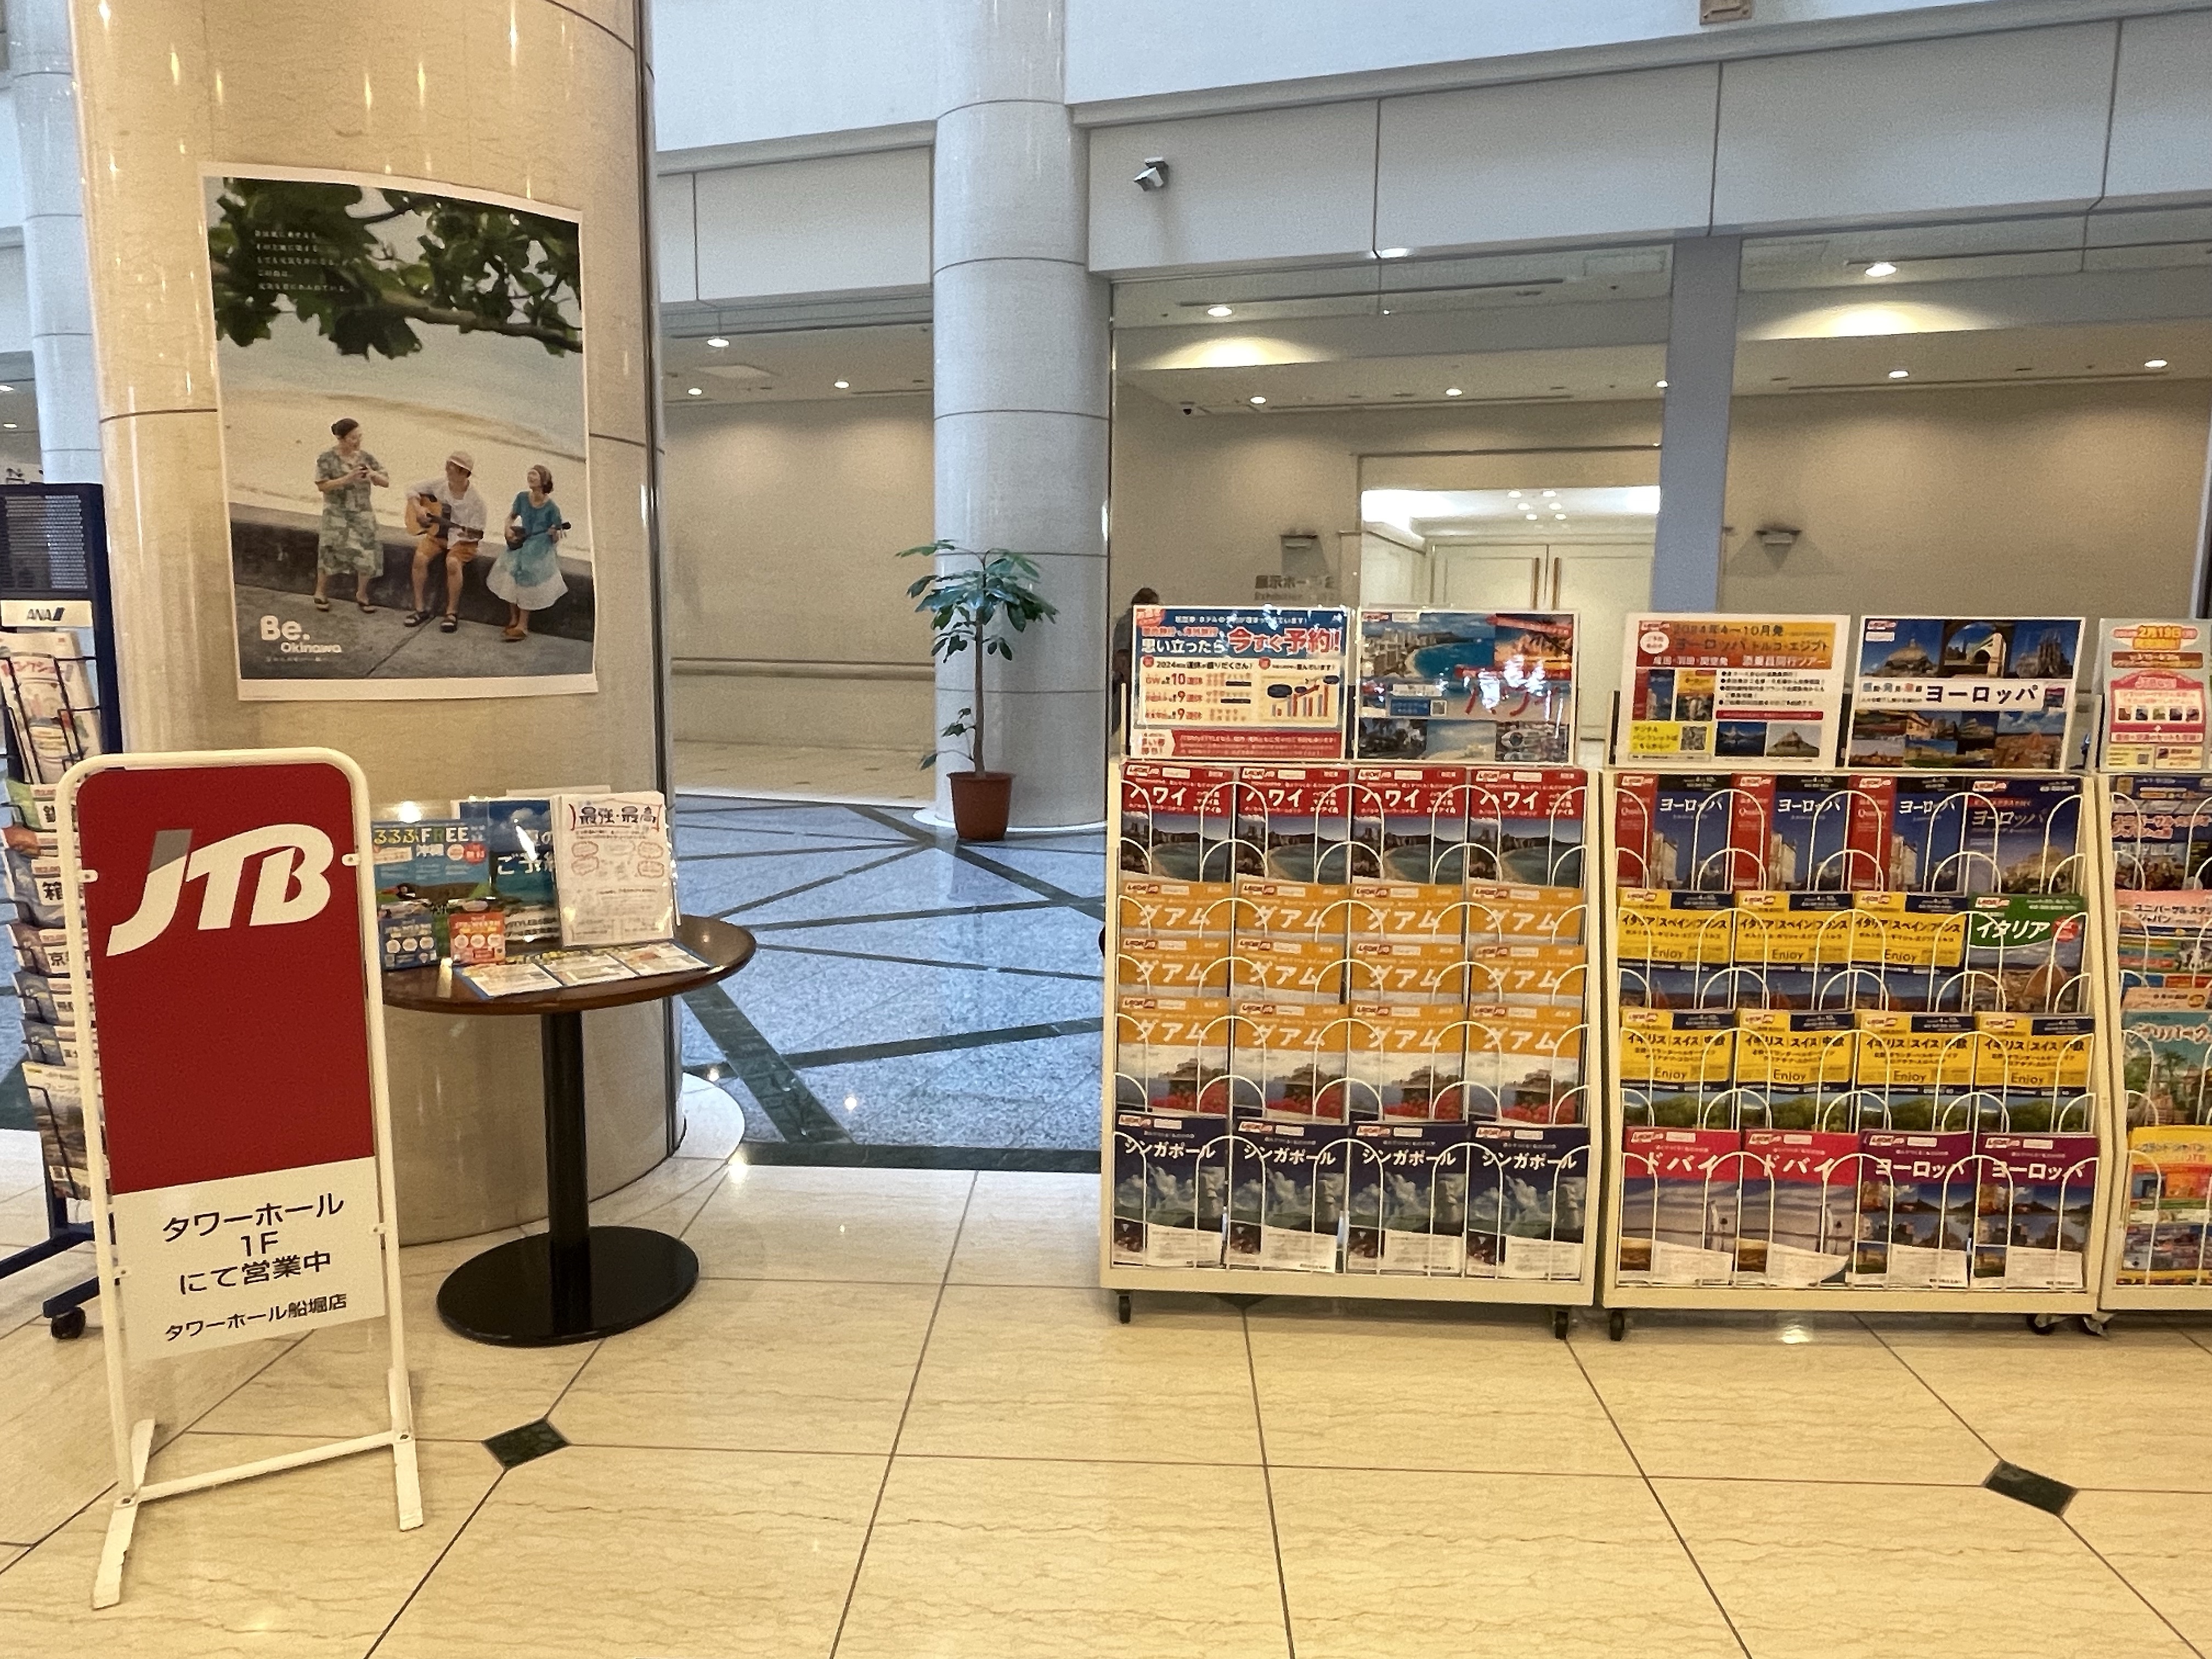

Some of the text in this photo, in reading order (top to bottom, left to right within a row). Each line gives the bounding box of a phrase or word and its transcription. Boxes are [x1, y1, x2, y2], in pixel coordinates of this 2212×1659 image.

[27, 608, 53, 620] ANA
[261, 615, 311, 640] Be.
[281, 642, 342, 653] Okinawa
[1142, 639, 1225, 654] 思い立ったら
[1926, 684, 2039, 704] ヨーロッパ
[1130, 787, 1187, 806] ハワイ
[1246, 788, 1303, 808] ハワイ
[1362, 789, 1420, 808] ハワイ
[1480, 790, 1539, 810] ハワイ
[1971, 808, 2049, 828] ヨーロッパ
[421, 826, 469, 843] FREE
[106, 823, 334, 956] JTB
[1139, 905, 1210, 926] グアム
[1255, 906, 1325, 928] グアム
[1368, 909, 1440, 930] グアム
[1486, 909, 1558, 932] グアム
[1977, 919, 2051, 940] イタリア
[1651, 946, 1684, 959] Enjoy
[1771, 948, 1804, 961] Enjoy
[1884, 949, 1917, 963] Enjoy
[1137, 960, 1207, 983] グアム
[1249, 961, 1319, 985] グアム
[1369, 964, 1442, 988] グアム
[1487, 967, 1560, 989] グアム
[1136, 1018, 1207, 1042] グアム
[1253, 1024, 1325, 1046] グアム
[1368, 1025, 1442, 1048] グアム
[1482, 1027, 1557, 1049] グアム
[1654, 1066, 1688, 1080] Enjoy
[1773, 1069, 1807, 1081] Enjoy
[1893, 1070, 1927, 1083] Enjoy
[2011, 1071, 2045, 1085] Enjoy
[1125, 1140, 1216, 1159] シンガポール
[1244, 1144, 1336, 1165] シンガポール
[1361, 1149, 1457, 1167] シンガポール
[1482, 1152, 1578, 1170] シンガポール
[1647, 1152, 1718, 1179] ドバイ
[1763, 1154, 1835, 1181] ドバイ
[163, 1193, 344, 1242] タワーホール
[240, 1231, 279, 1257] 1F
[179, 1250, 330, 1295] にて営業中
[165, 1293, 347, 1342] タワーホール船堀店
